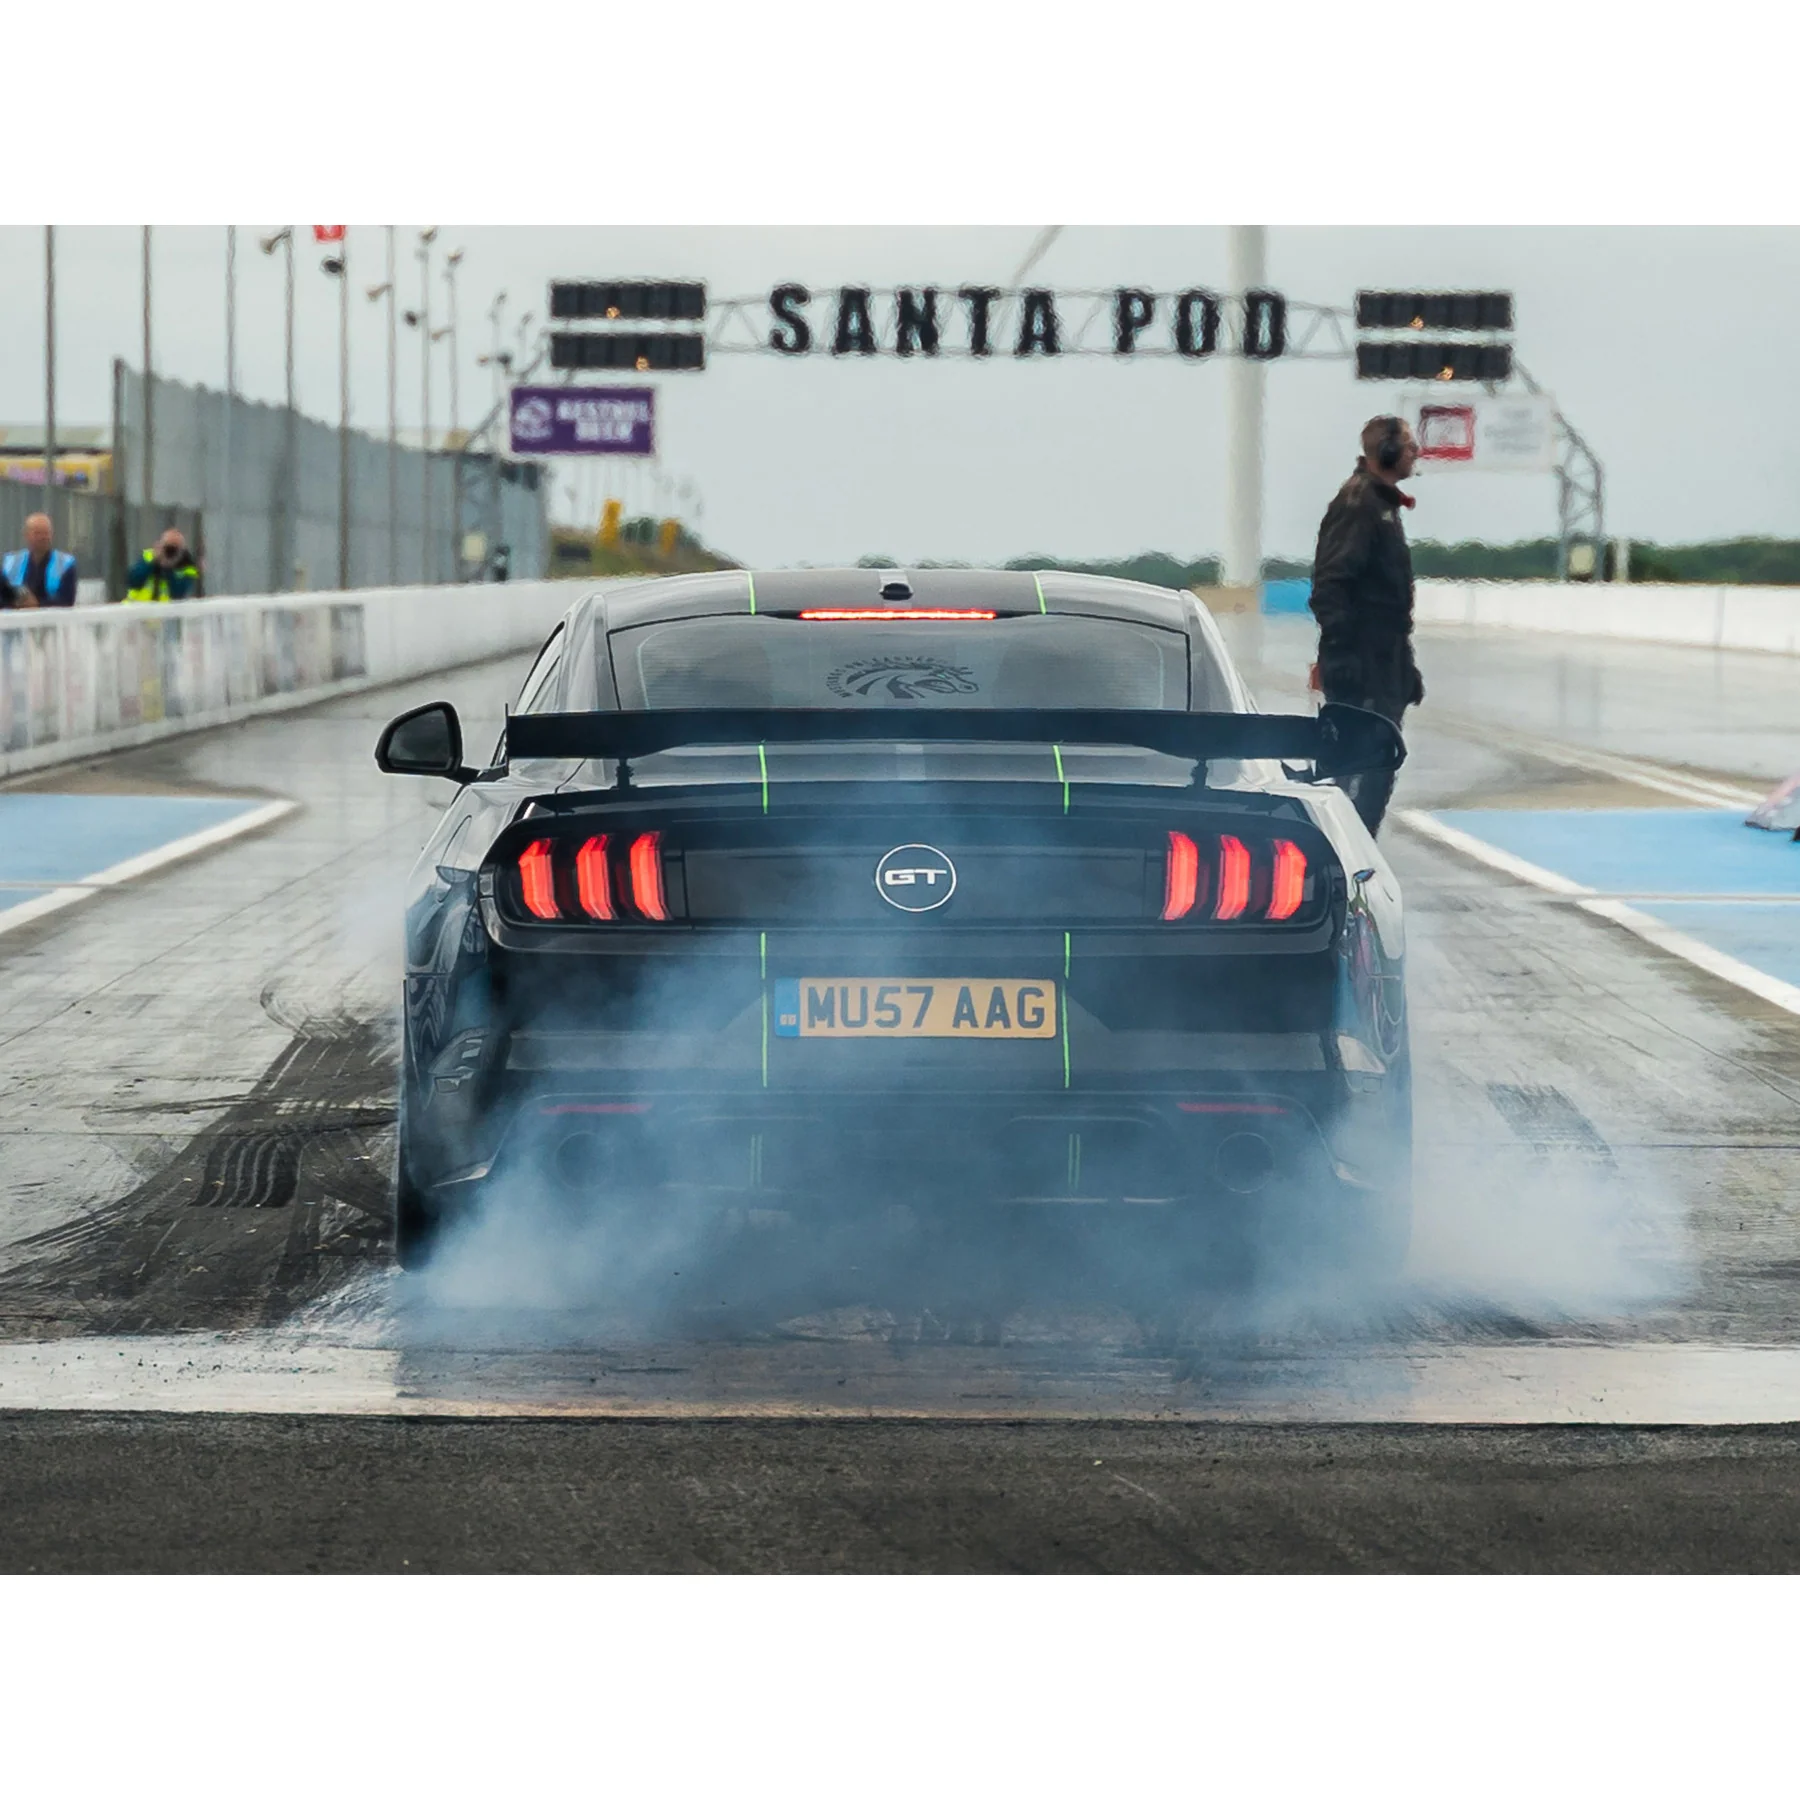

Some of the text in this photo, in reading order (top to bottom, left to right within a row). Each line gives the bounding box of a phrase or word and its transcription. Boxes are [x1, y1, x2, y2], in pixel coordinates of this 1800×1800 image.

[769, 284, 1288, 358] SANTA POD
[885, 869, 947, 885] GT
[807, 986, 1045, 1029] MU57 AAG
